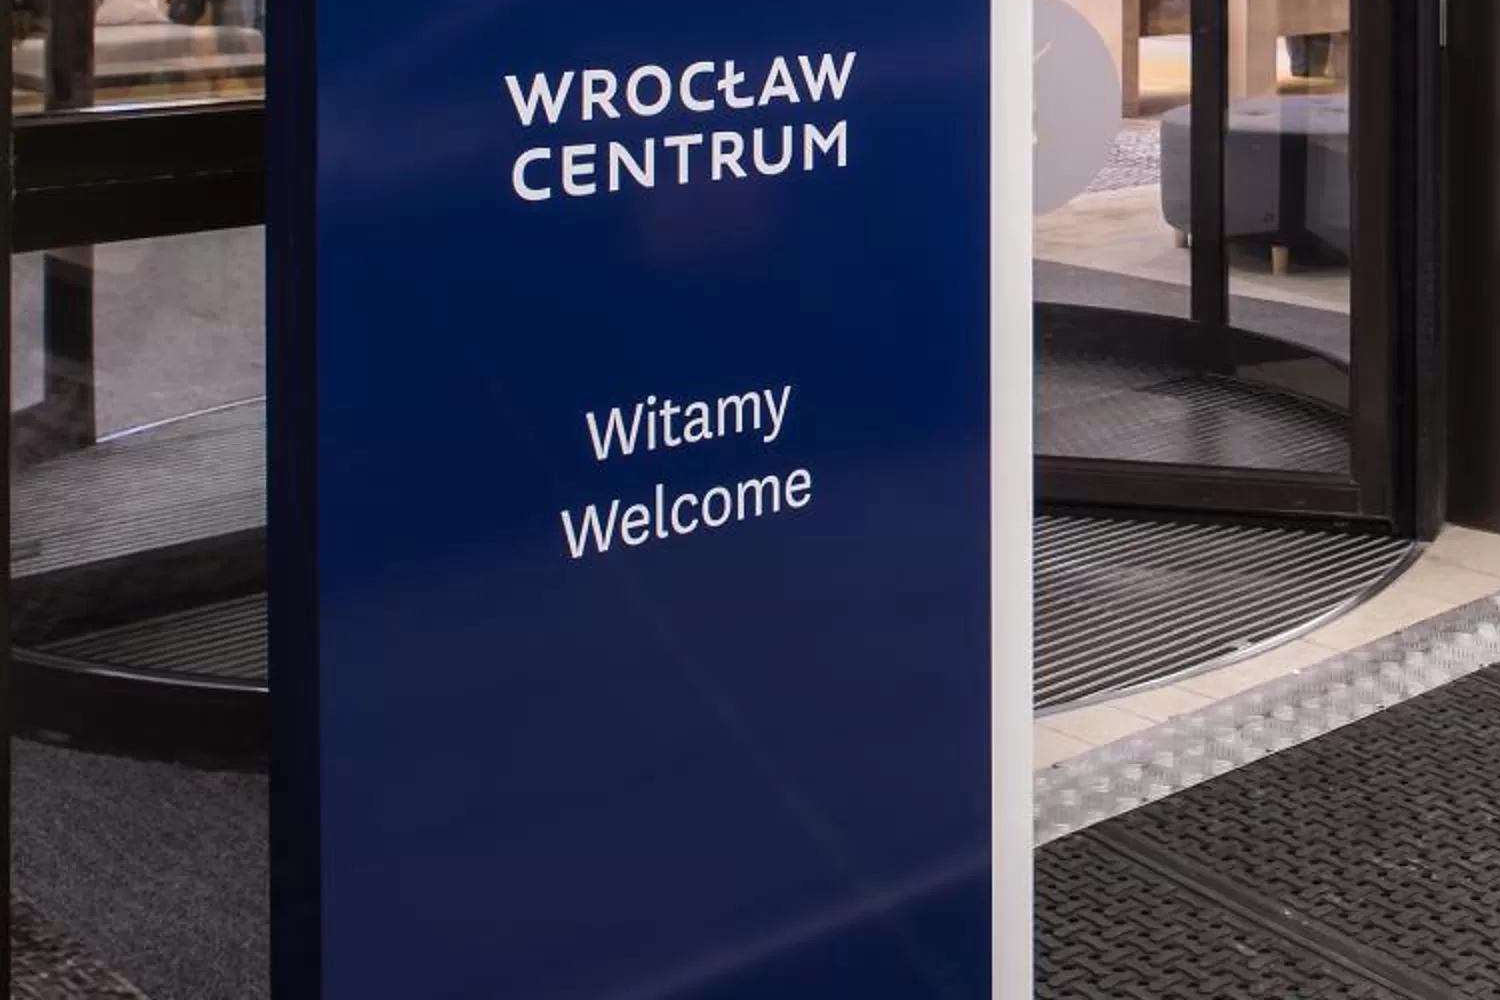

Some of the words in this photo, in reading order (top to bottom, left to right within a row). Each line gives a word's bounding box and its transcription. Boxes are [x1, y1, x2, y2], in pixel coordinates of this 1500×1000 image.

[504, 51, 858, 126] WROCŁAW
[512, 119, 848, 201] CENTRUM
[585, 385, 792, 461] Witamy
[560, 468, 812, 559] Welcome
